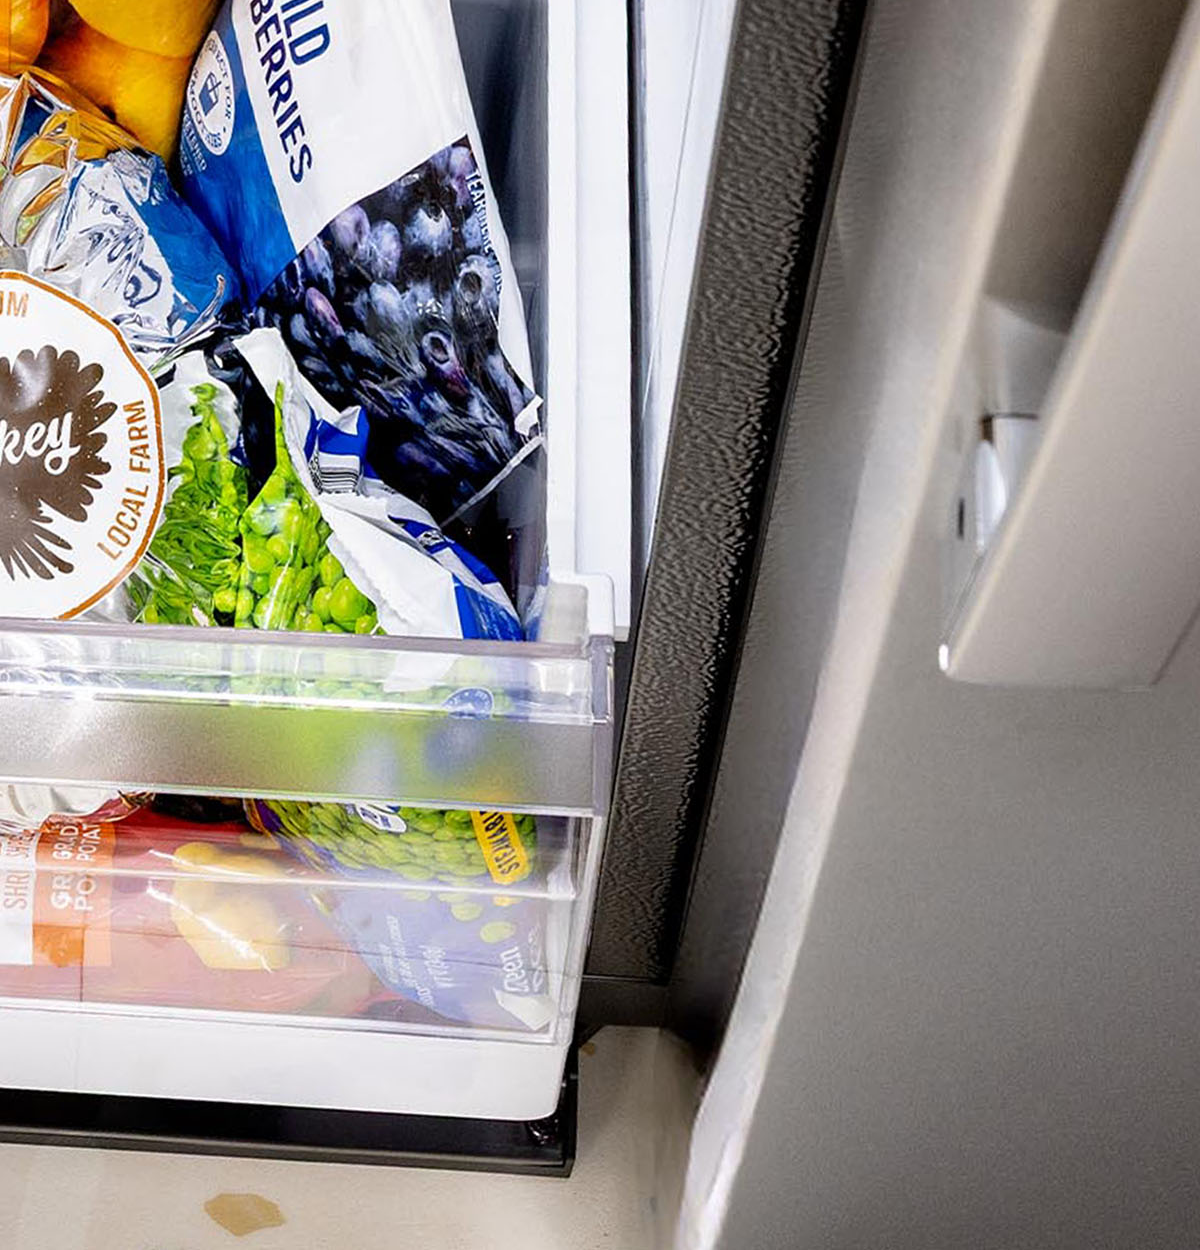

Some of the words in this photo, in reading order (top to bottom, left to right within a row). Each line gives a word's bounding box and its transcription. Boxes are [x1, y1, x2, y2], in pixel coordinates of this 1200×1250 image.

[464, 168, 487, 214] TEAR
[122, 399, 151, 473] FARM
[96, 485, 149, 561] LOCAL
